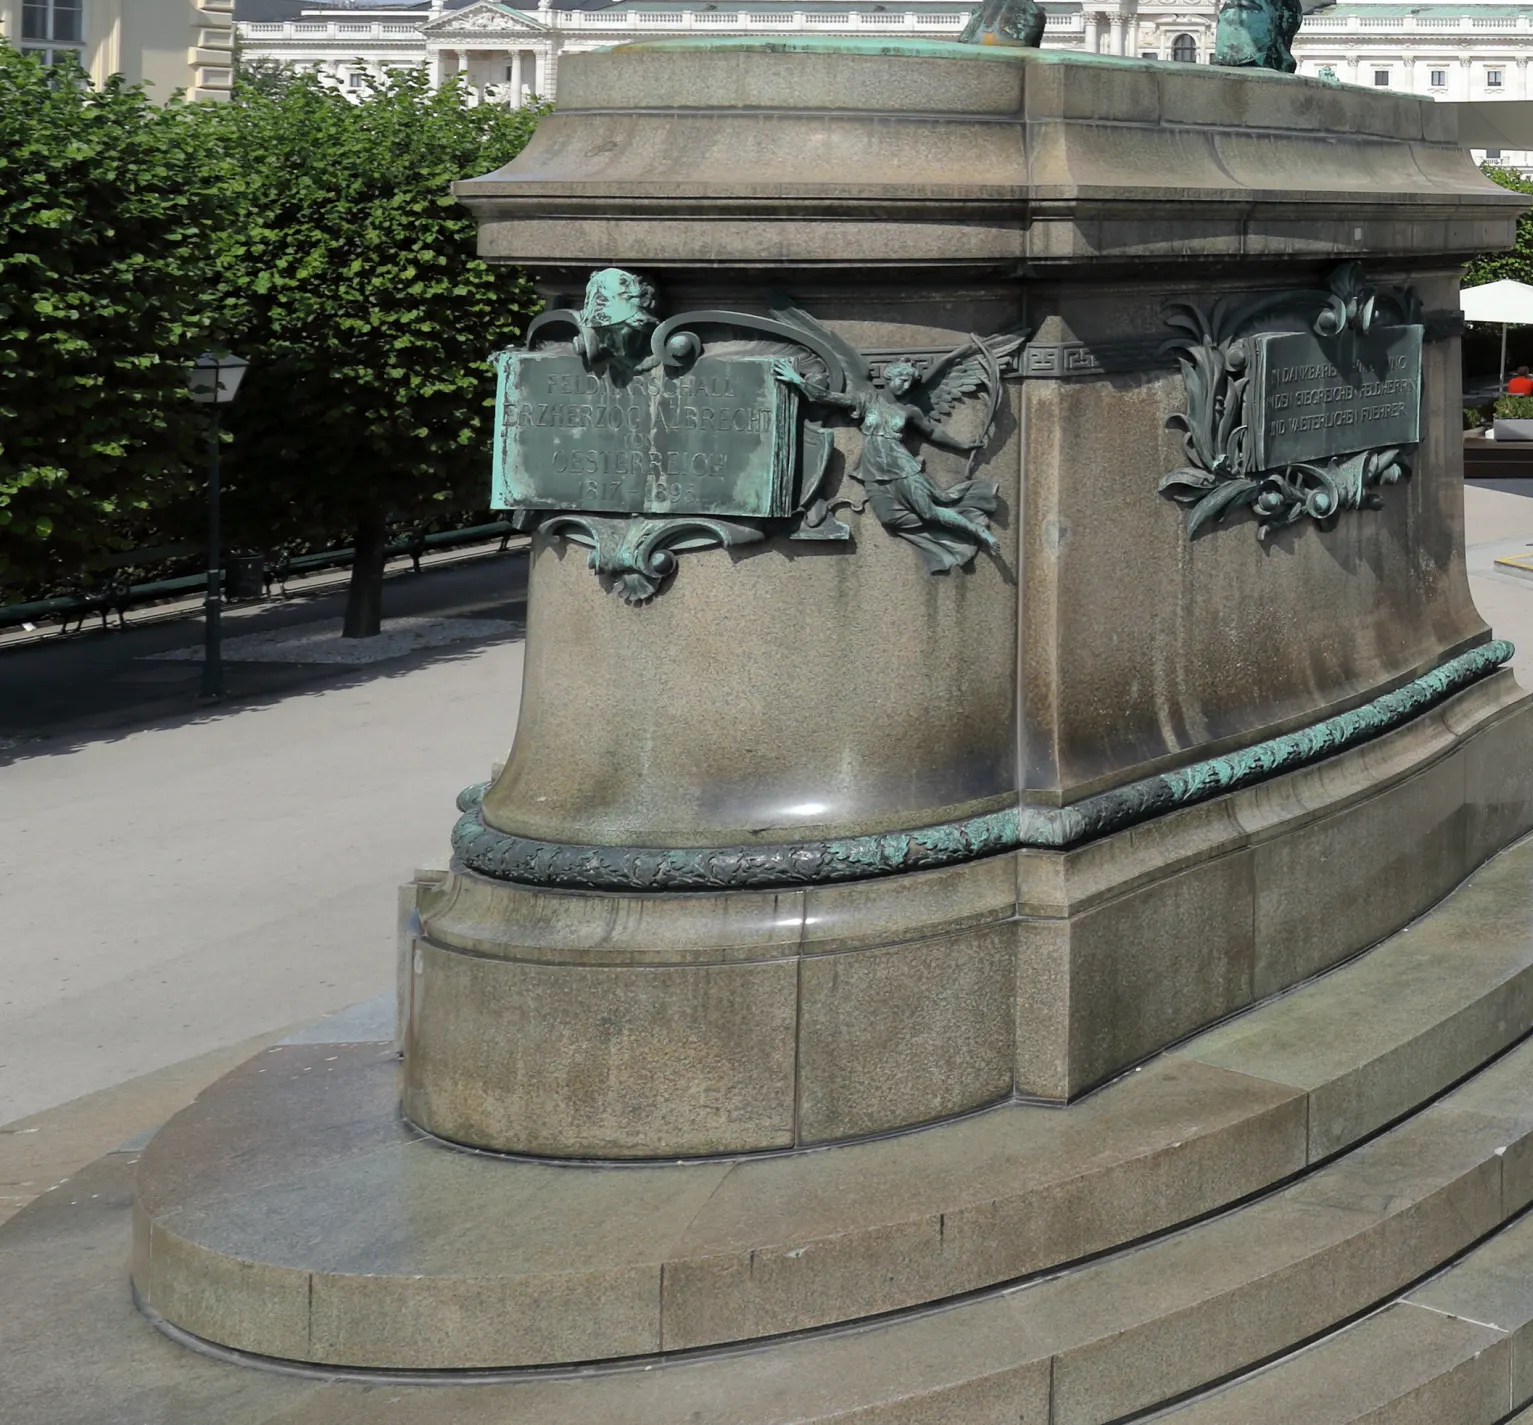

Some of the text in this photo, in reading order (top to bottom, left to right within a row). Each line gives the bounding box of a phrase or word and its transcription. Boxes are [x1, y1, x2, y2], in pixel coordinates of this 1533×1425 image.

[1283, 362, 1338, 385] DANKBARE
[502, 403, 773, 433] ERZHERZOG ALBRECHT
[1361, 402, 1407, 422] FUEHRER
[552, 450, 728, 478] OESTERREICH
[577, 480, 622, 502] 1817
